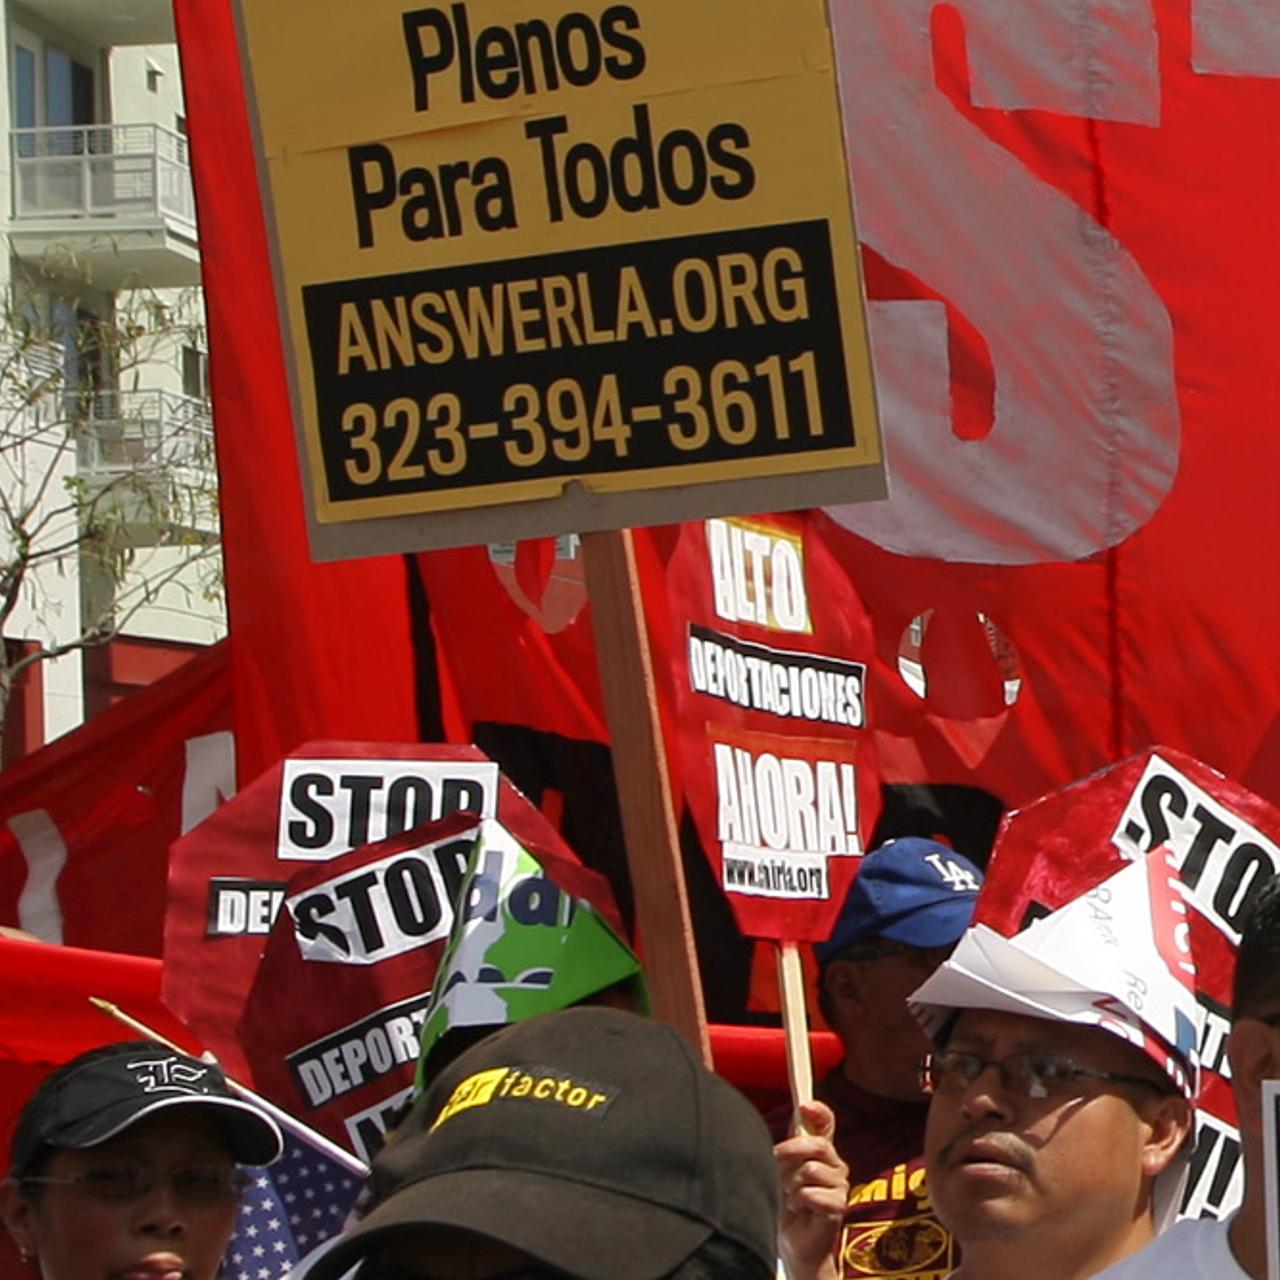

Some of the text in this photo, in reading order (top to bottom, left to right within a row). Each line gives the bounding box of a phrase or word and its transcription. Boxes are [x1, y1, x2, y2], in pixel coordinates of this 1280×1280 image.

[402, 2, 646, 111] Plenos
[347, 106, 756, 248] Para Todos
[337, 246, 810, 376] ANSWERLA.ORG
[341, 350, 824, 486] 323-394-3611
[709, 517, 807, 632] ALTO
[690, 636, 862, 727] DEPORTACIONES
[288, 773, 484, 849] STOP
[714, 742, 863, 856] AHORA!
[1124, 774, 1277, 928] STO
[924, 853, 980, 891] LA
[499, 1069, 607, 1110] factor
